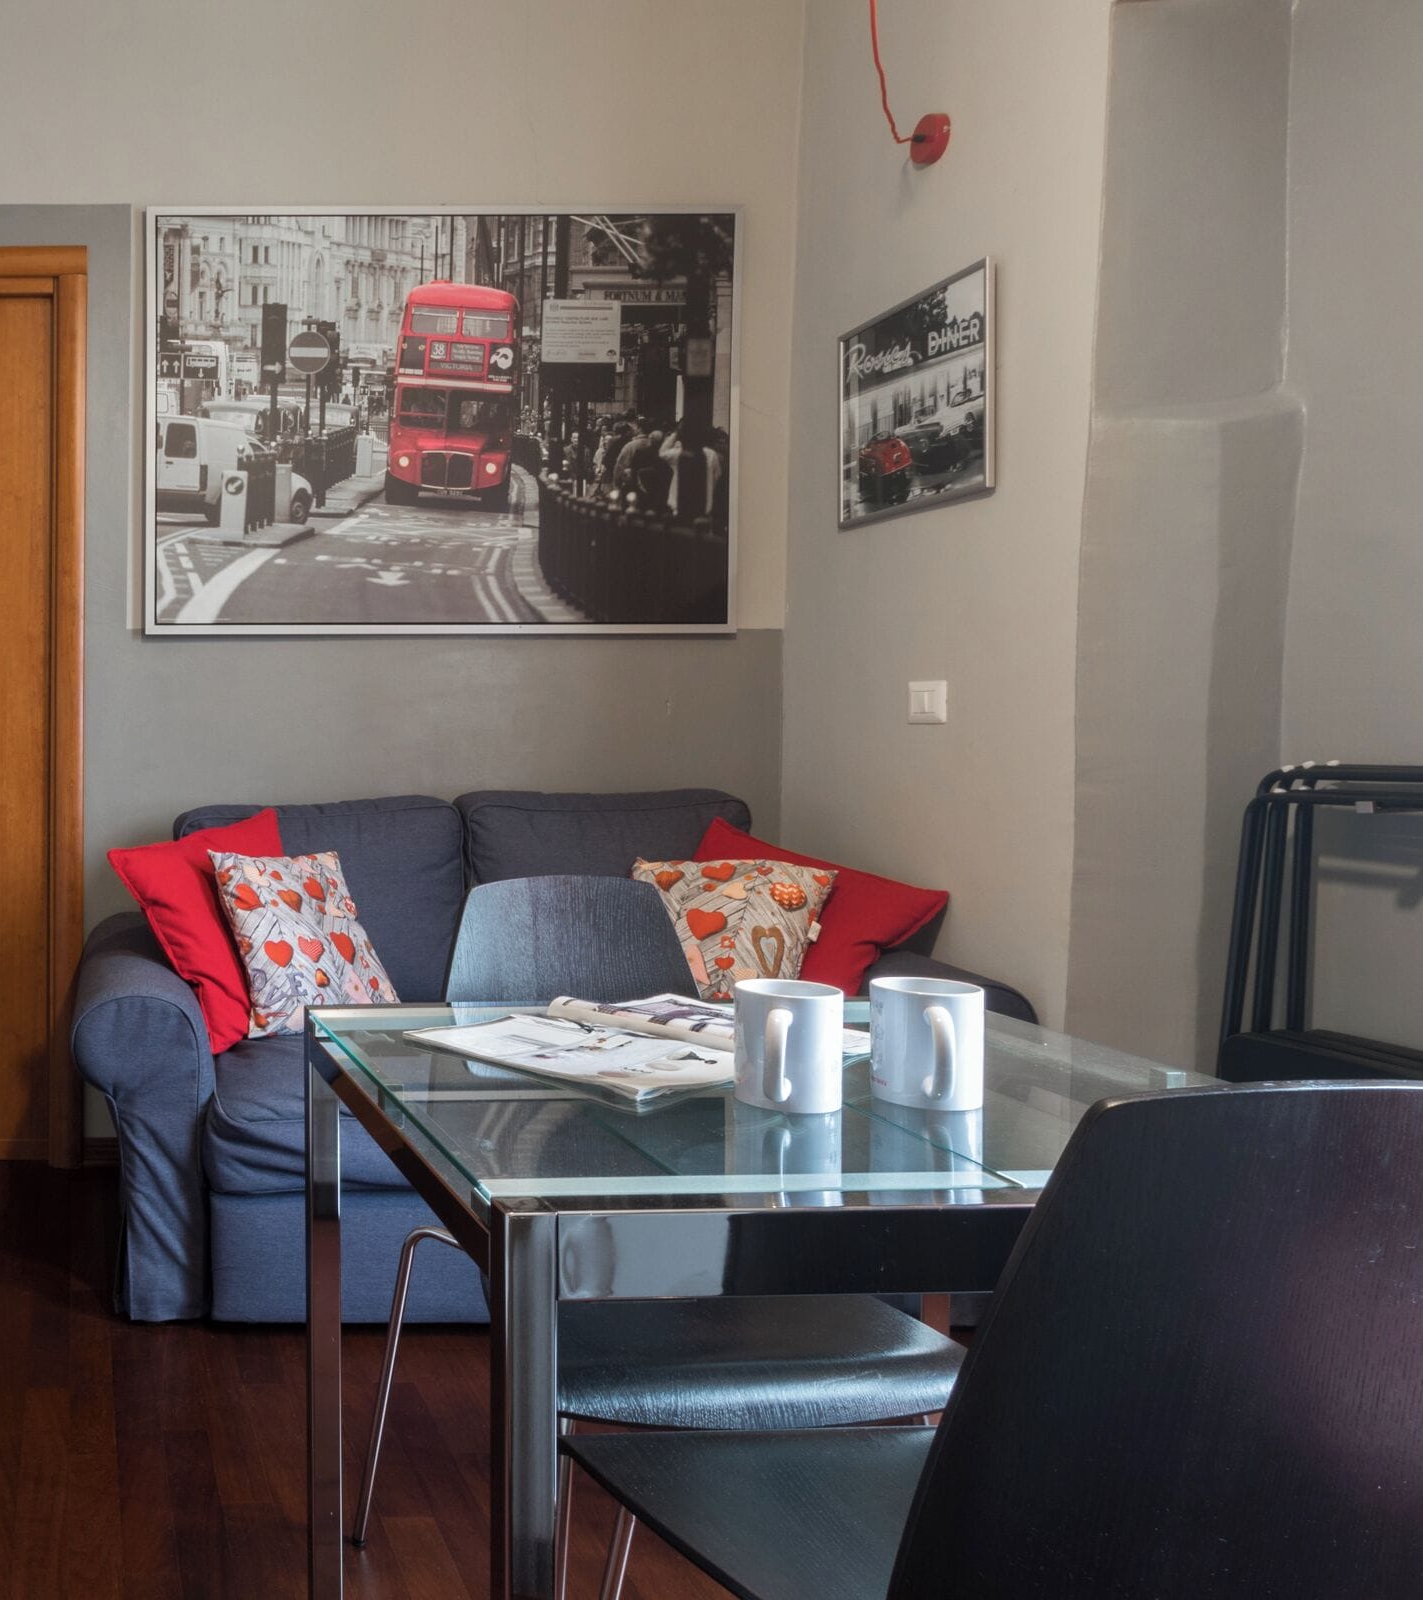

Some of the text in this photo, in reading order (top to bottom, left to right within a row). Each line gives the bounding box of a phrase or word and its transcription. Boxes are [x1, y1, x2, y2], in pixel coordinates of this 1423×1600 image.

[928, 318, 980, 357] DINER
[432, 342, 445, 355] 38
[440, 362, 474, 371] VICTORIA
